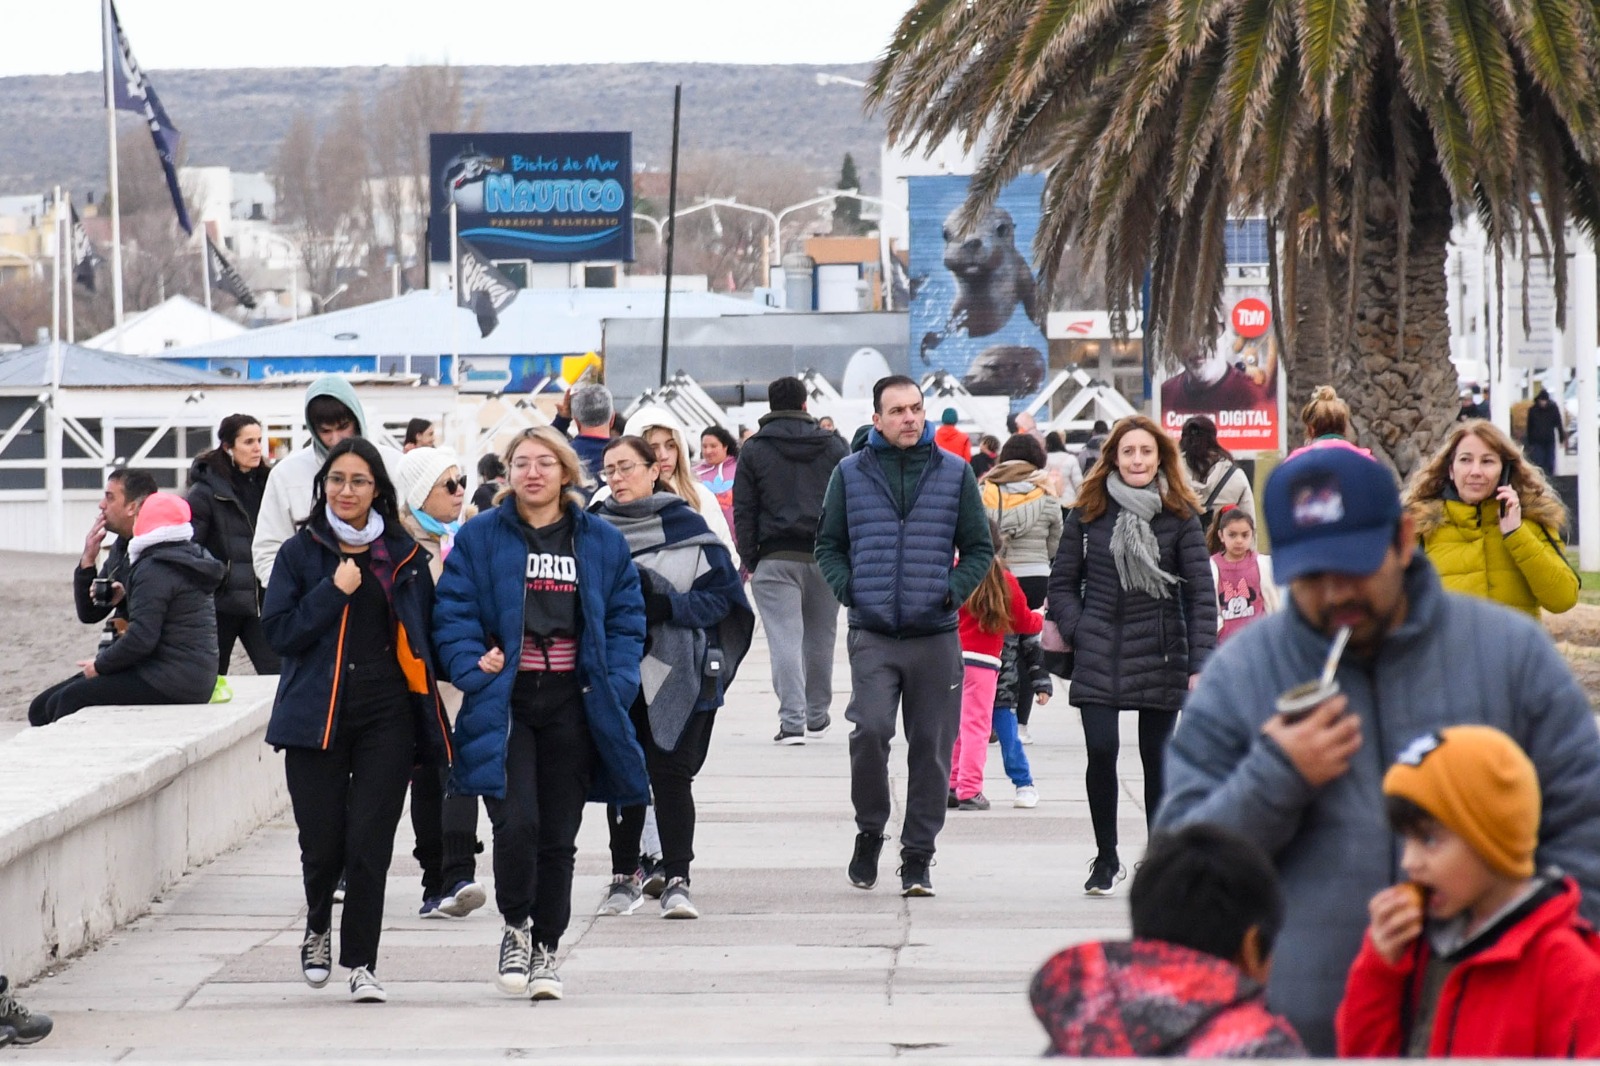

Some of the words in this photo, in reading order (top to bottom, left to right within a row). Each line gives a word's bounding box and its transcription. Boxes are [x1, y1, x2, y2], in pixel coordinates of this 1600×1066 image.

[512, 155, 558, 171] Bistró
[563, 157, 582, 171] de
[586, 154, 618, 172] Mar
[486, 174, 624, 212] NAUTICO
[1219, 410, 1272, 427] DIGITAL
[526, 553, 578, 583] ORID
